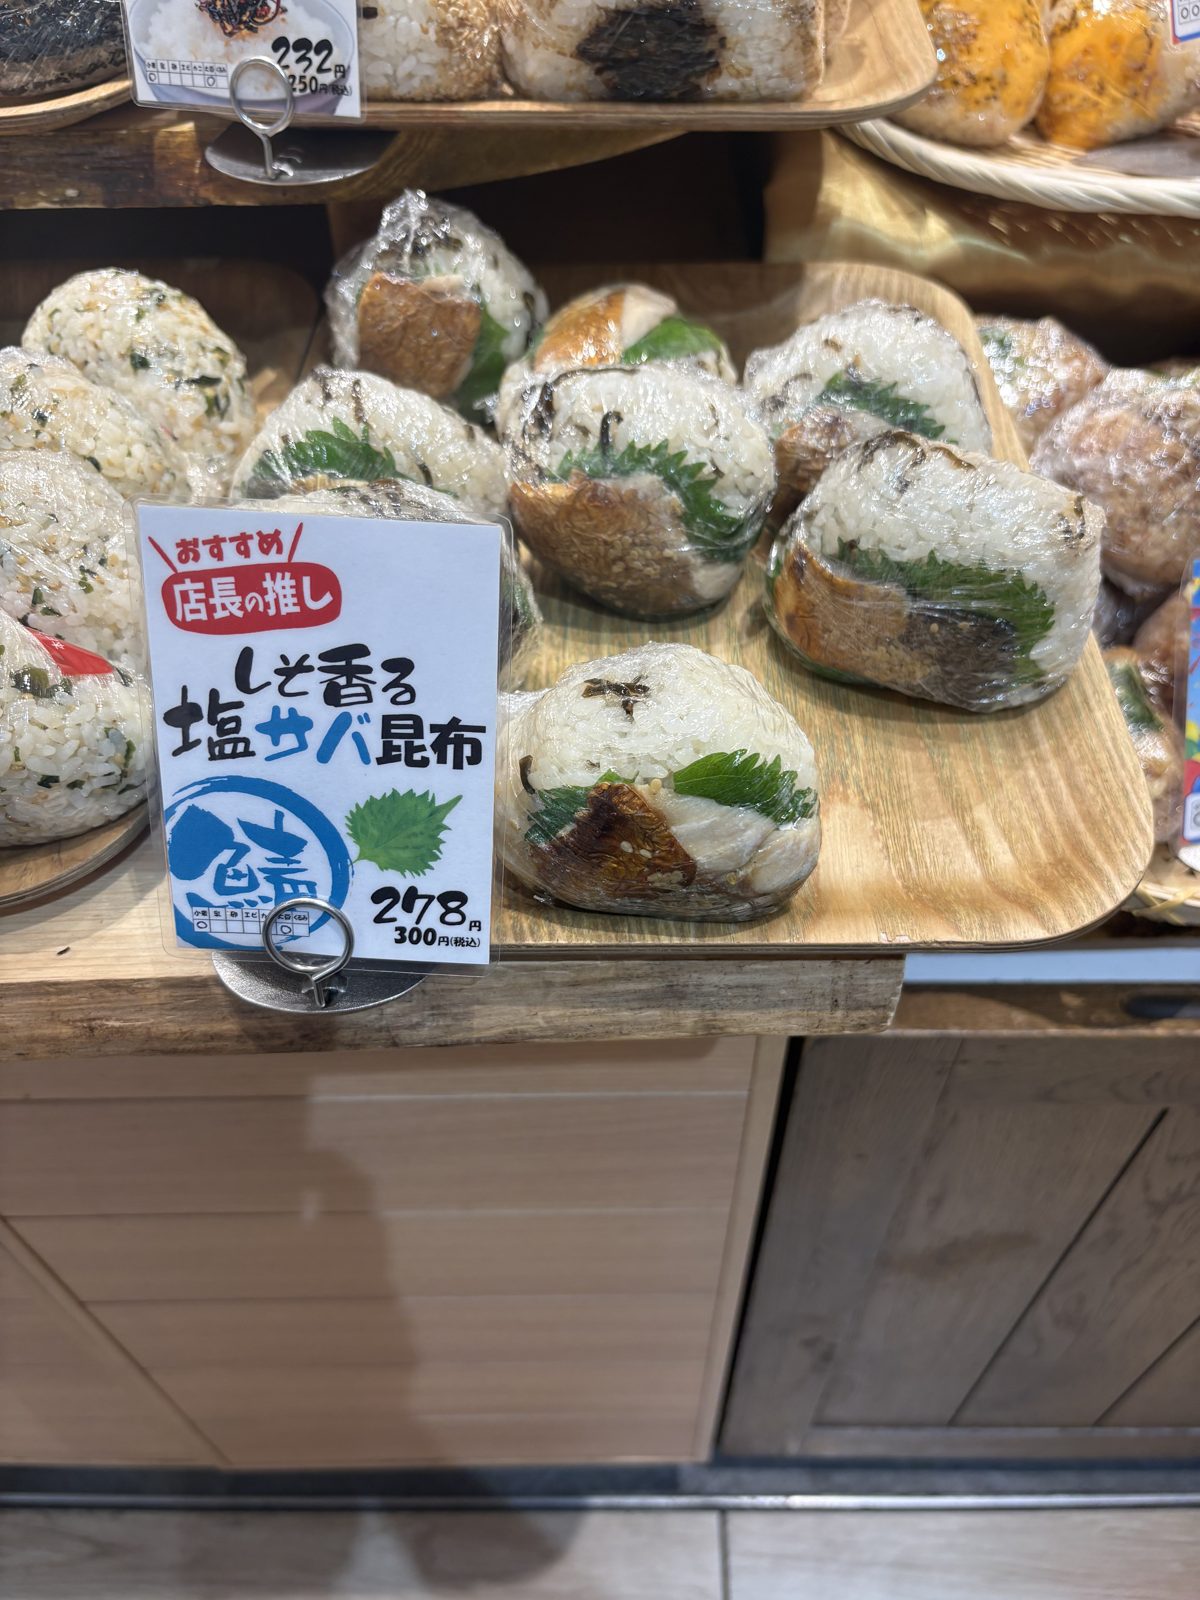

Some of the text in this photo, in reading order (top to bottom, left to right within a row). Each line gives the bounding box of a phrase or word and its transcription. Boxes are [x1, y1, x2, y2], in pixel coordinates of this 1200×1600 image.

[175, 528, 284, 564] おすすめ
[172, 571, 334, 623] 店長の推し
[234, 643, 417, 708] しそ香る
[162, 684, 487, 771] 塩サバ昆布
[370, 885, 482, 932] 278円
[394, 926, 481, 947] 300円(税込)
